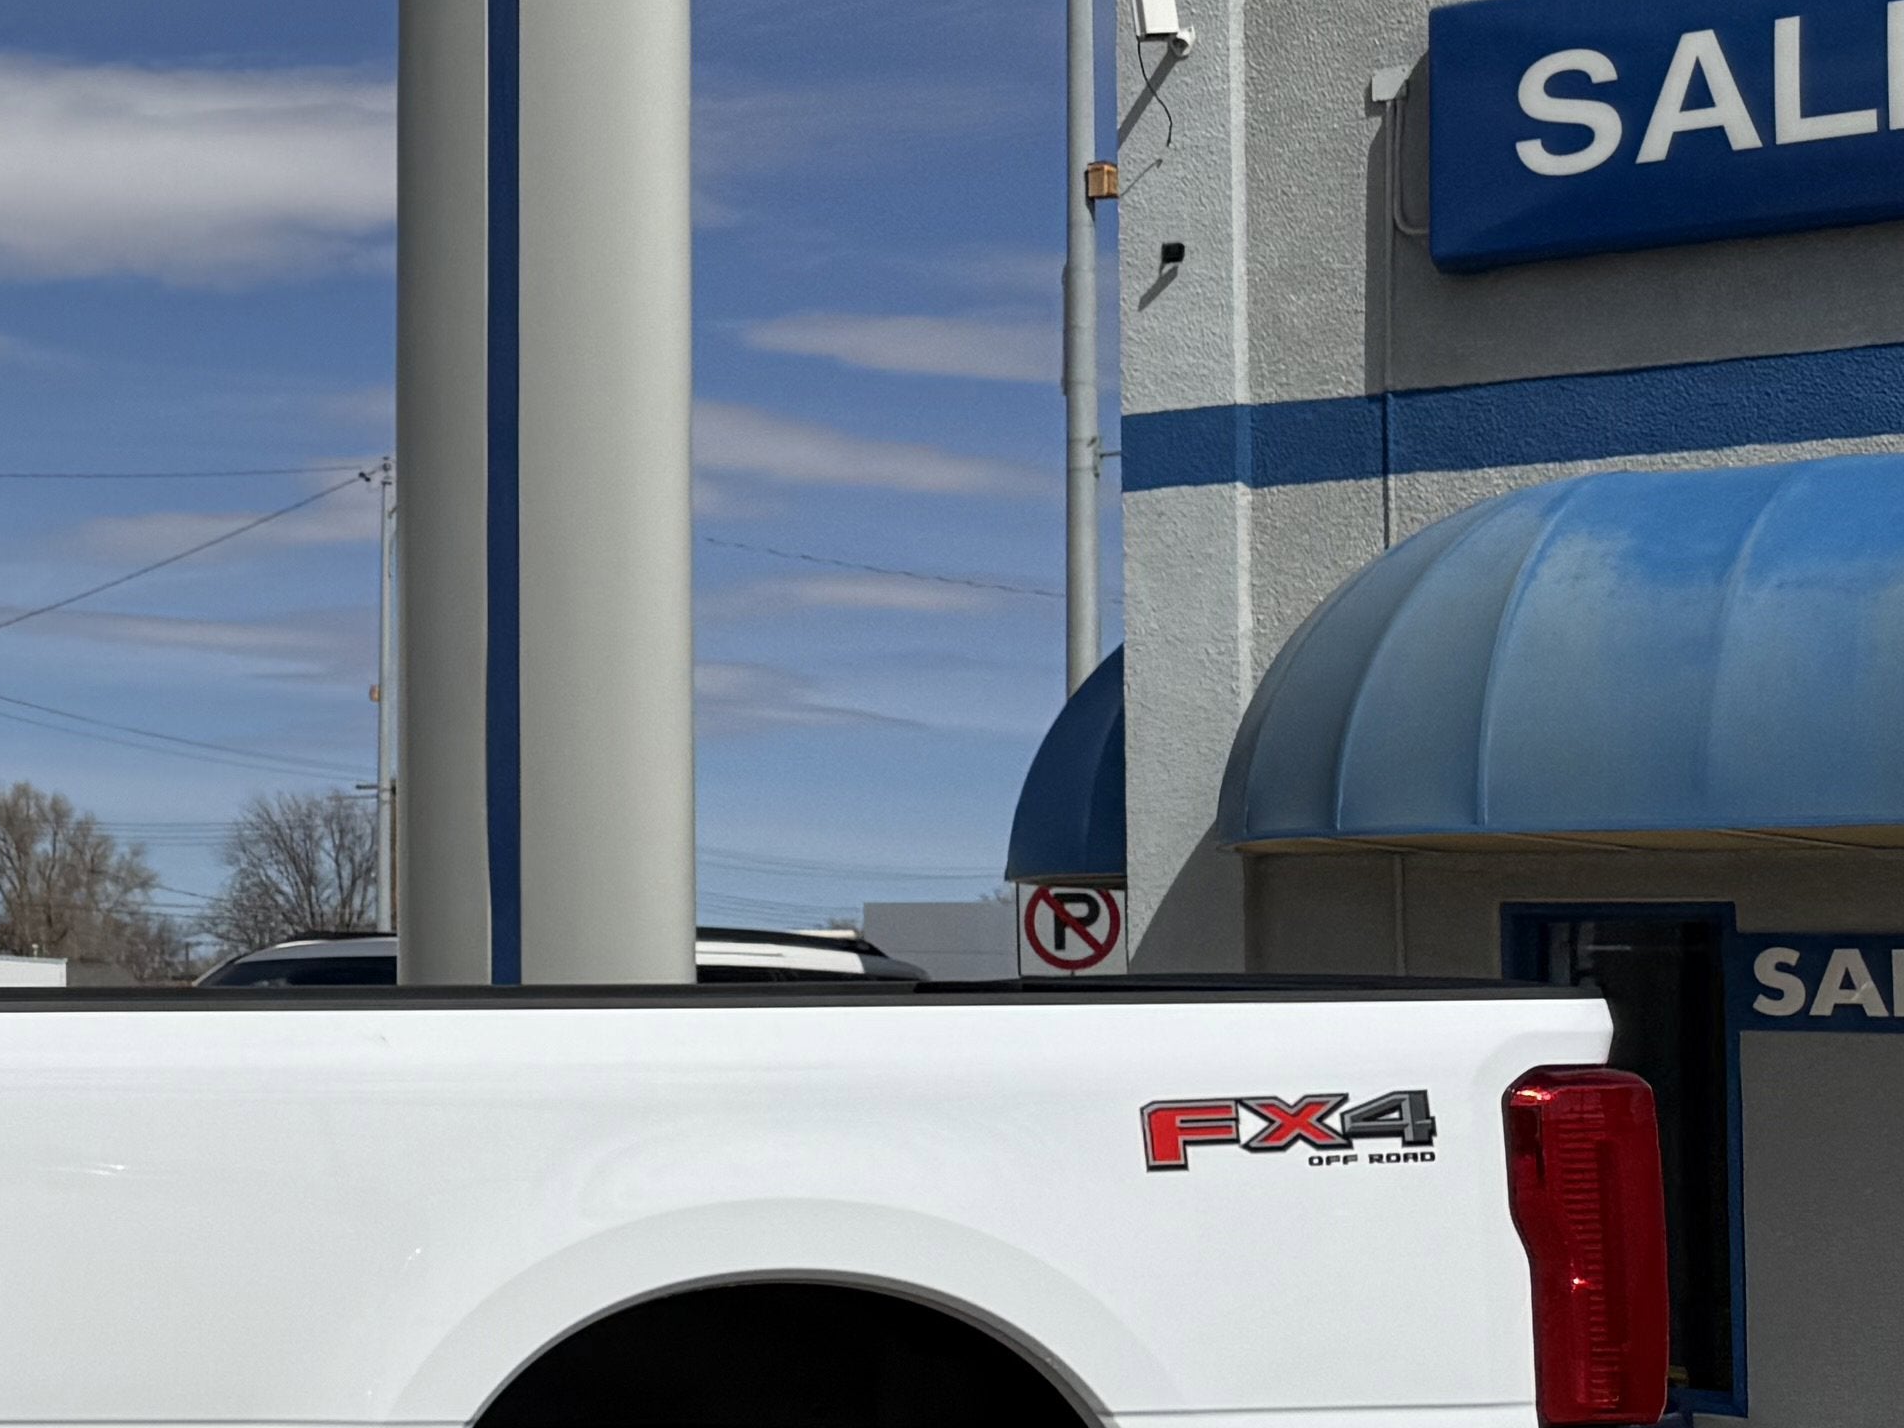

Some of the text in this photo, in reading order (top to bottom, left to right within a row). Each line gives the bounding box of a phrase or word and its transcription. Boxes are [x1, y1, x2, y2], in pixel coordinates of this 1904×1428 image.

[1515, 0, 1904, 177] SAL
[1752, 947, 1904, 1017] SA
[1140, 1090, 1438, 1172] FX4
[1308, 1151, 1436, 1166] OFF ROAD
